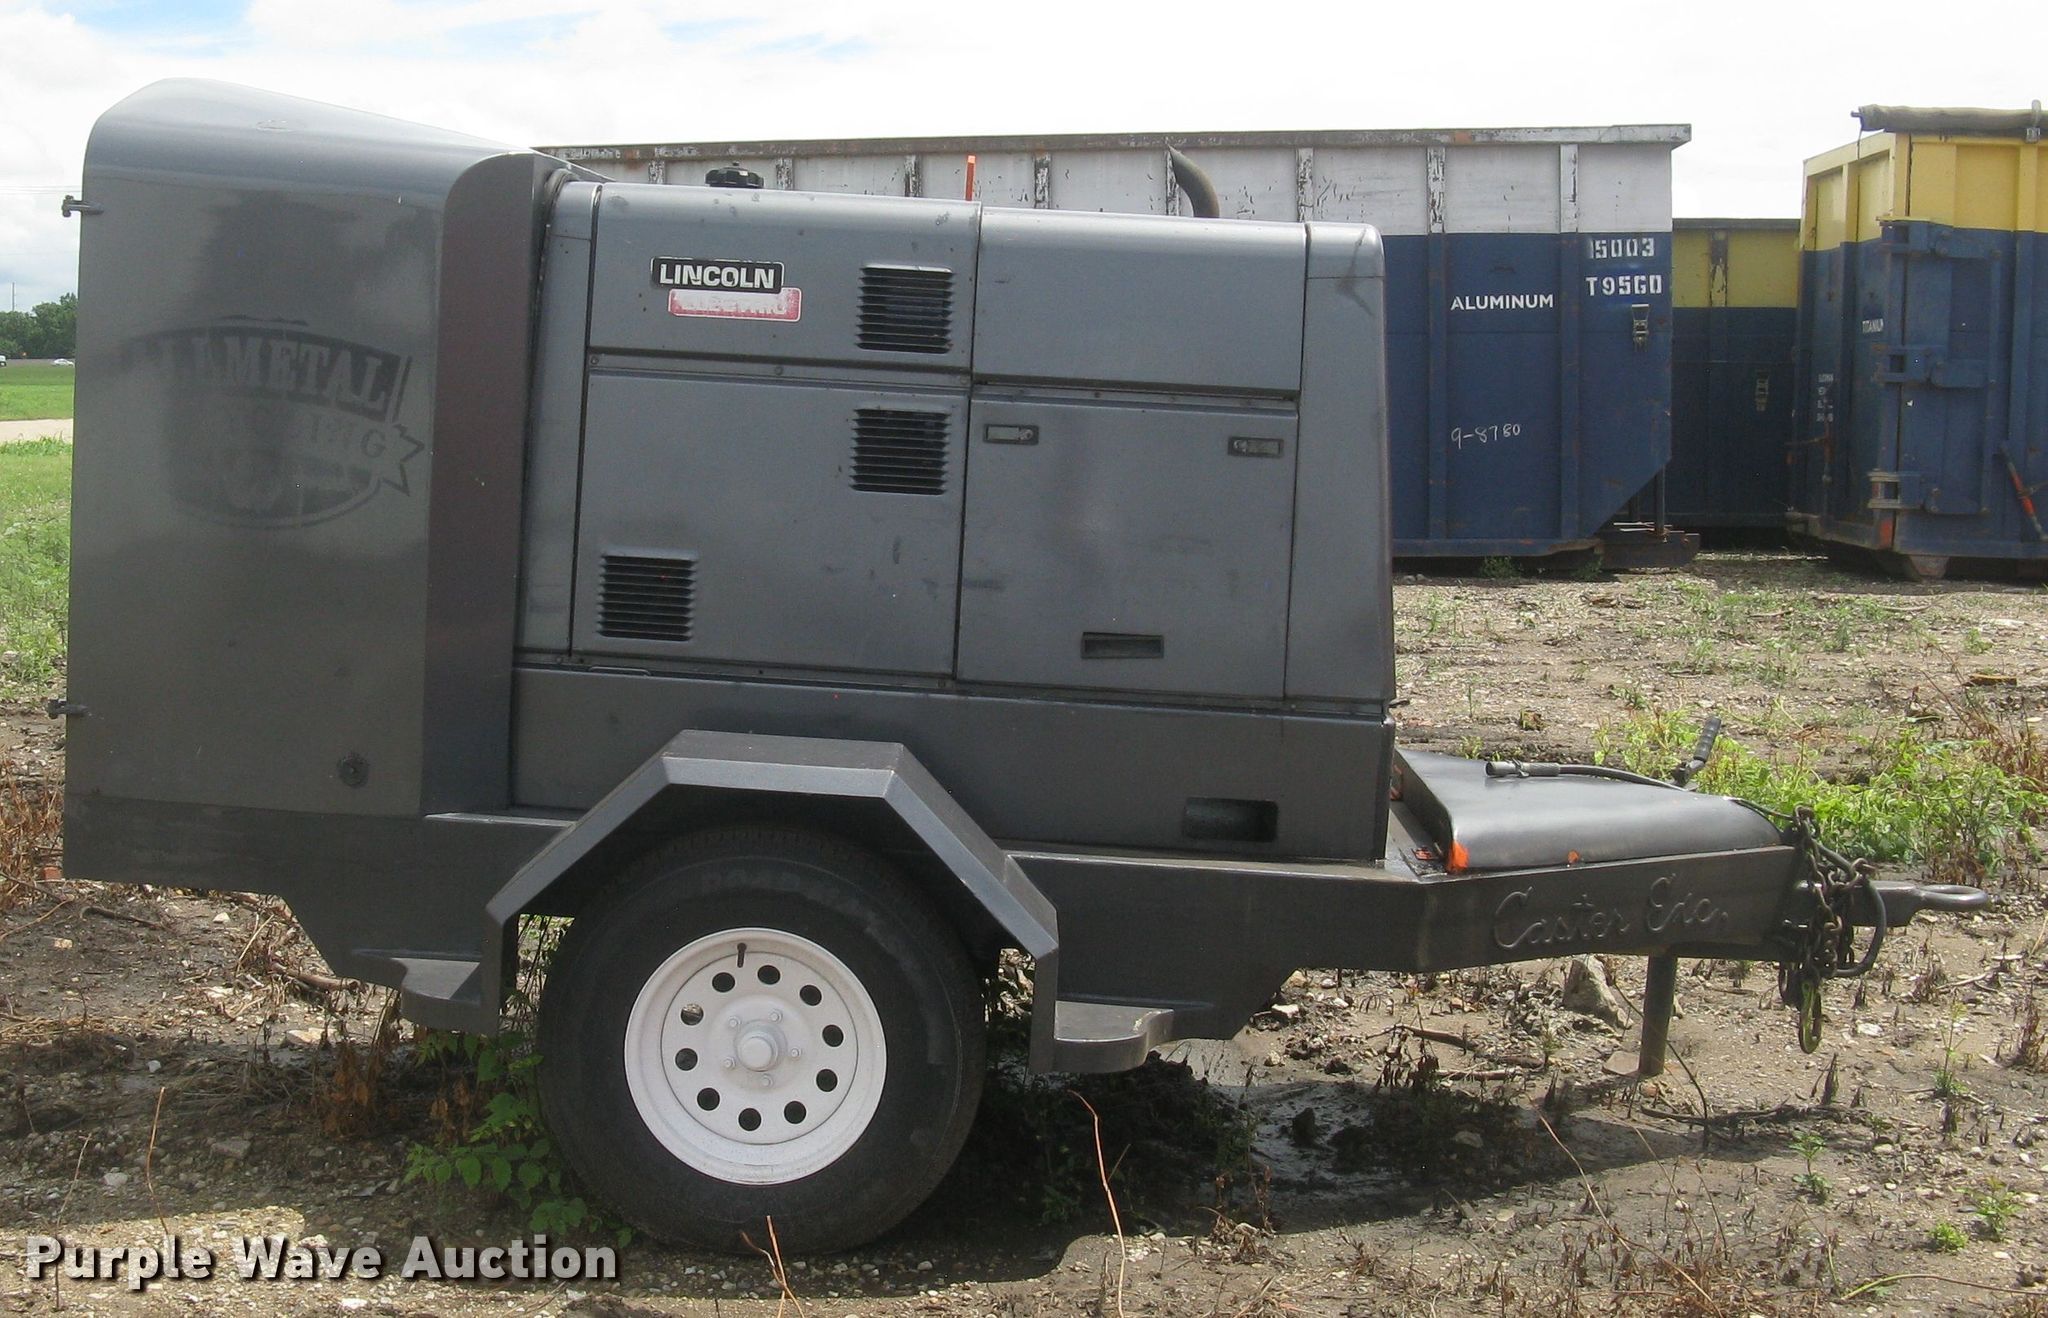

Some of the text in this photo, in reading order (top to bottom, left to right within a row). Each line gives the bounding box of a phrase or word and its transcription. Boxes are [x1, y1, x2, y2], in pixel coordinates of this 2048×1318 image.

[659, 263, 775, 289] LINCOLN
[1450, 294, 1554, 312] ALUMINUM
[1451, 423, 1521, 450] 9-8780
